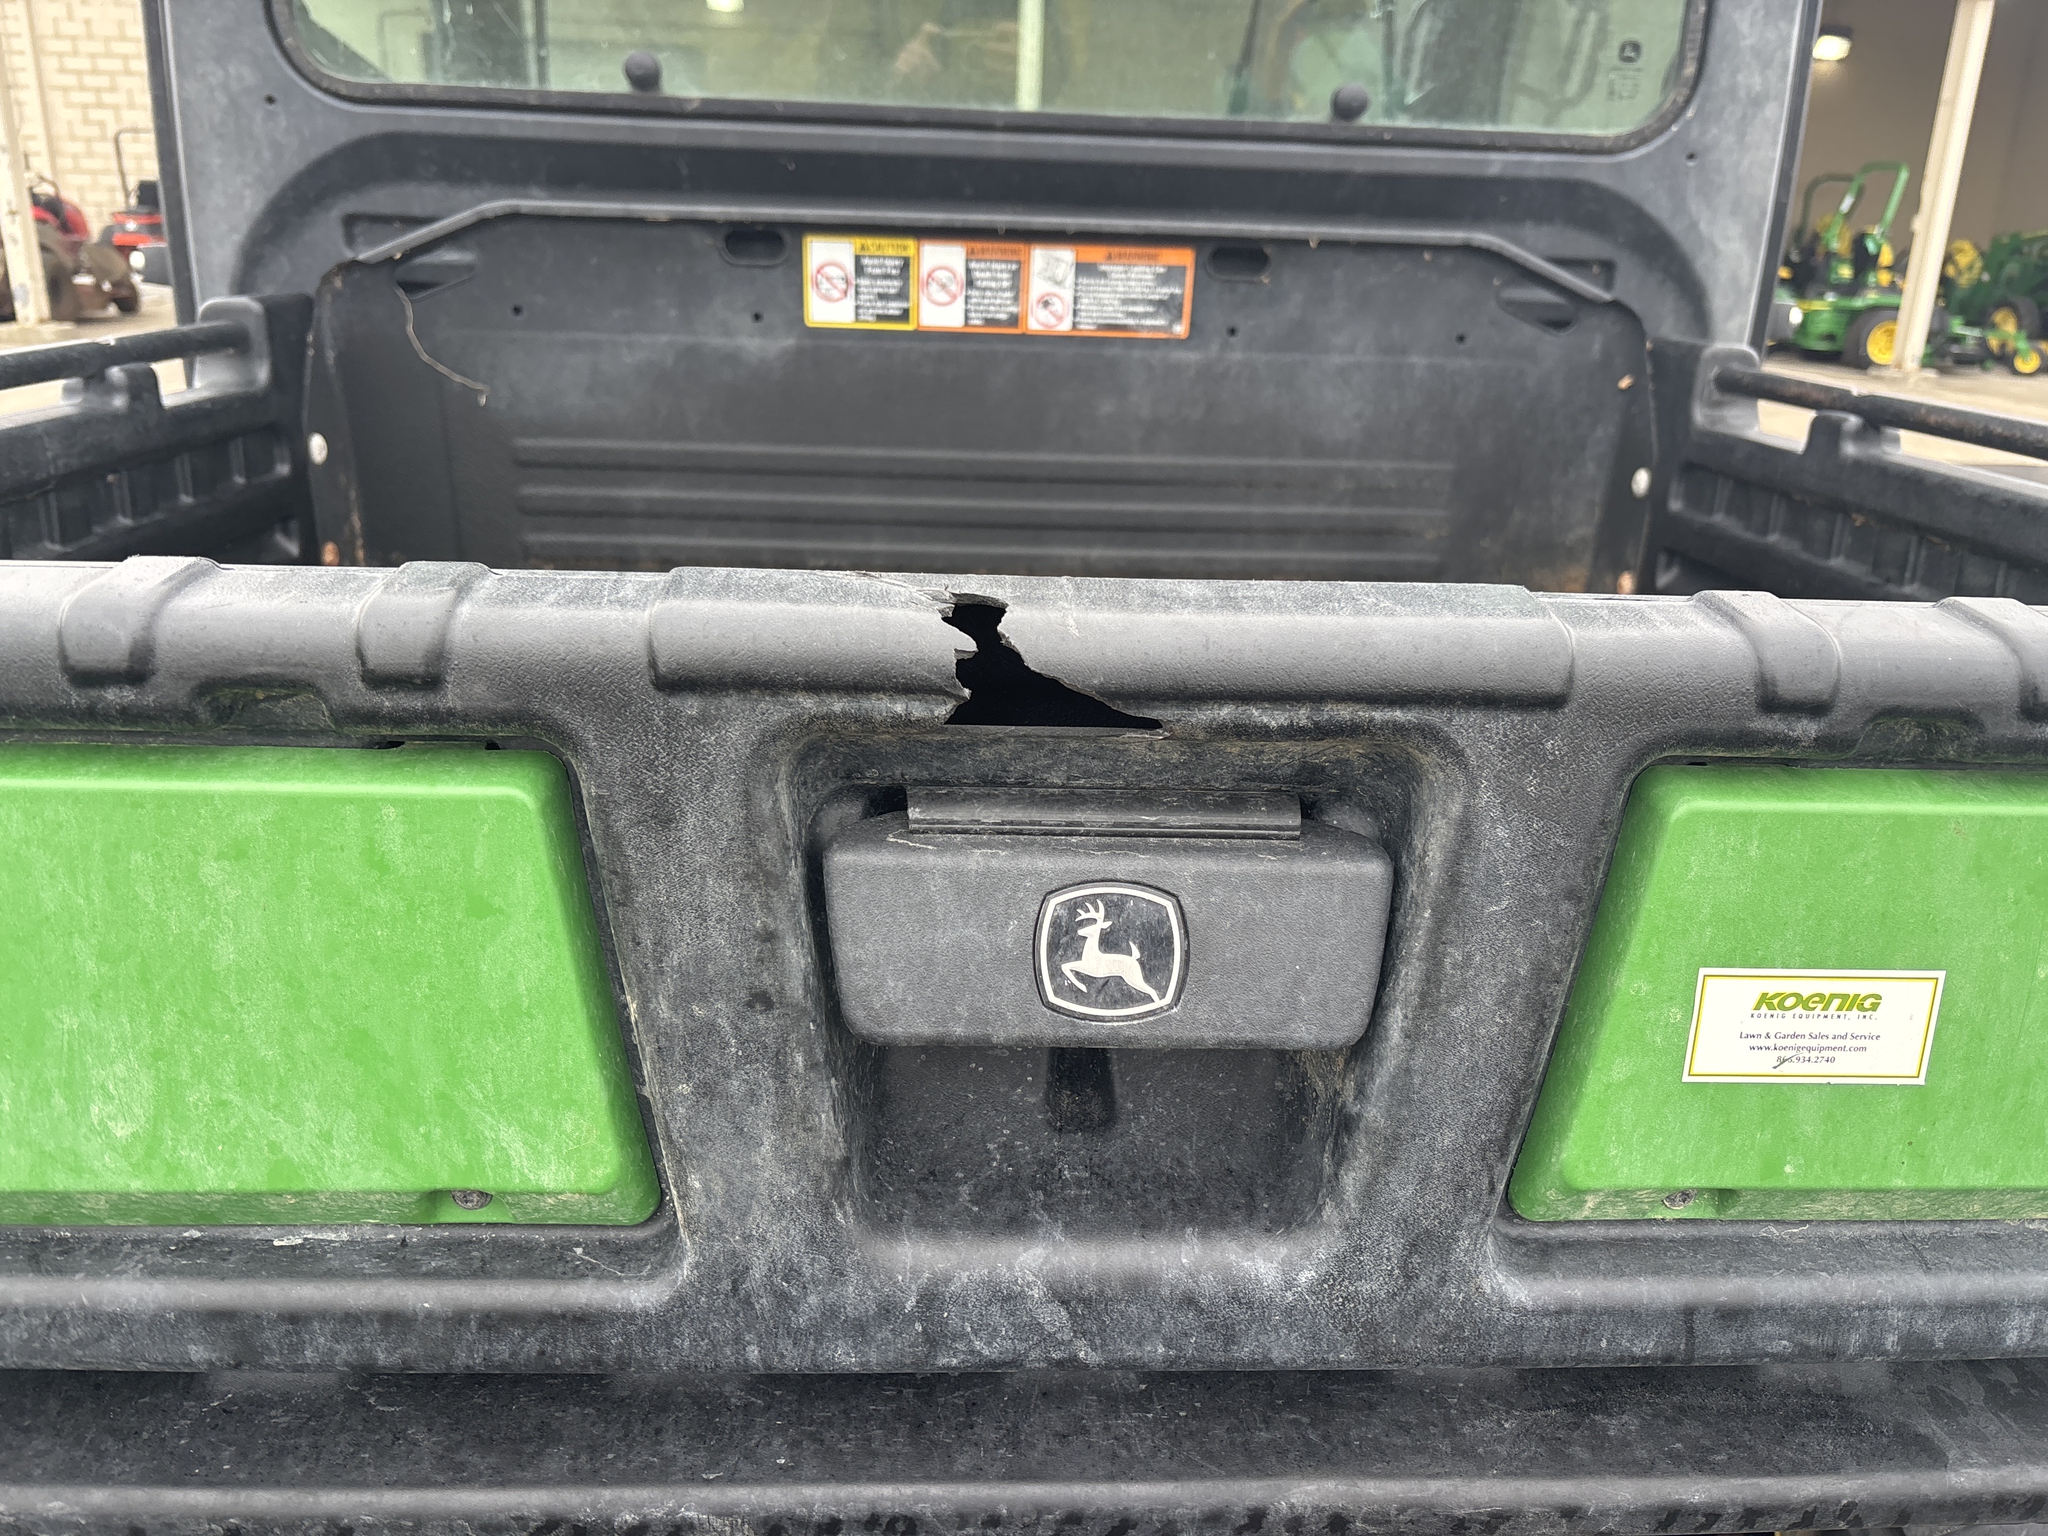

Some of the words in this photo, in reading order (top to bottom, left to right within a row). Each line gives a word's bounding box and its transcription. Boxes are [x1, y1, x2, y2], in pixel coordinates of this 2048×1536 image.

[1749, 1012, 1787, 1020] KOENIG
[1791, 1013, 1851, 1021] EQUIPMENT,
[1857, 1013, 1878, 1021] INC.
[1739, 1031, 1762, 1040] Lawn
[1764, 1031, 1772, 1040] &
[1774, 1031, 1806, 1040] Garden
[1808, 1031, 1830, 1040] Sales
[1831, 1031, 1848, 1040] and
[1849, 1032, 1881, 1041] Service
[1748, 1043, 1867, 1054] www.koenigequipment.com
